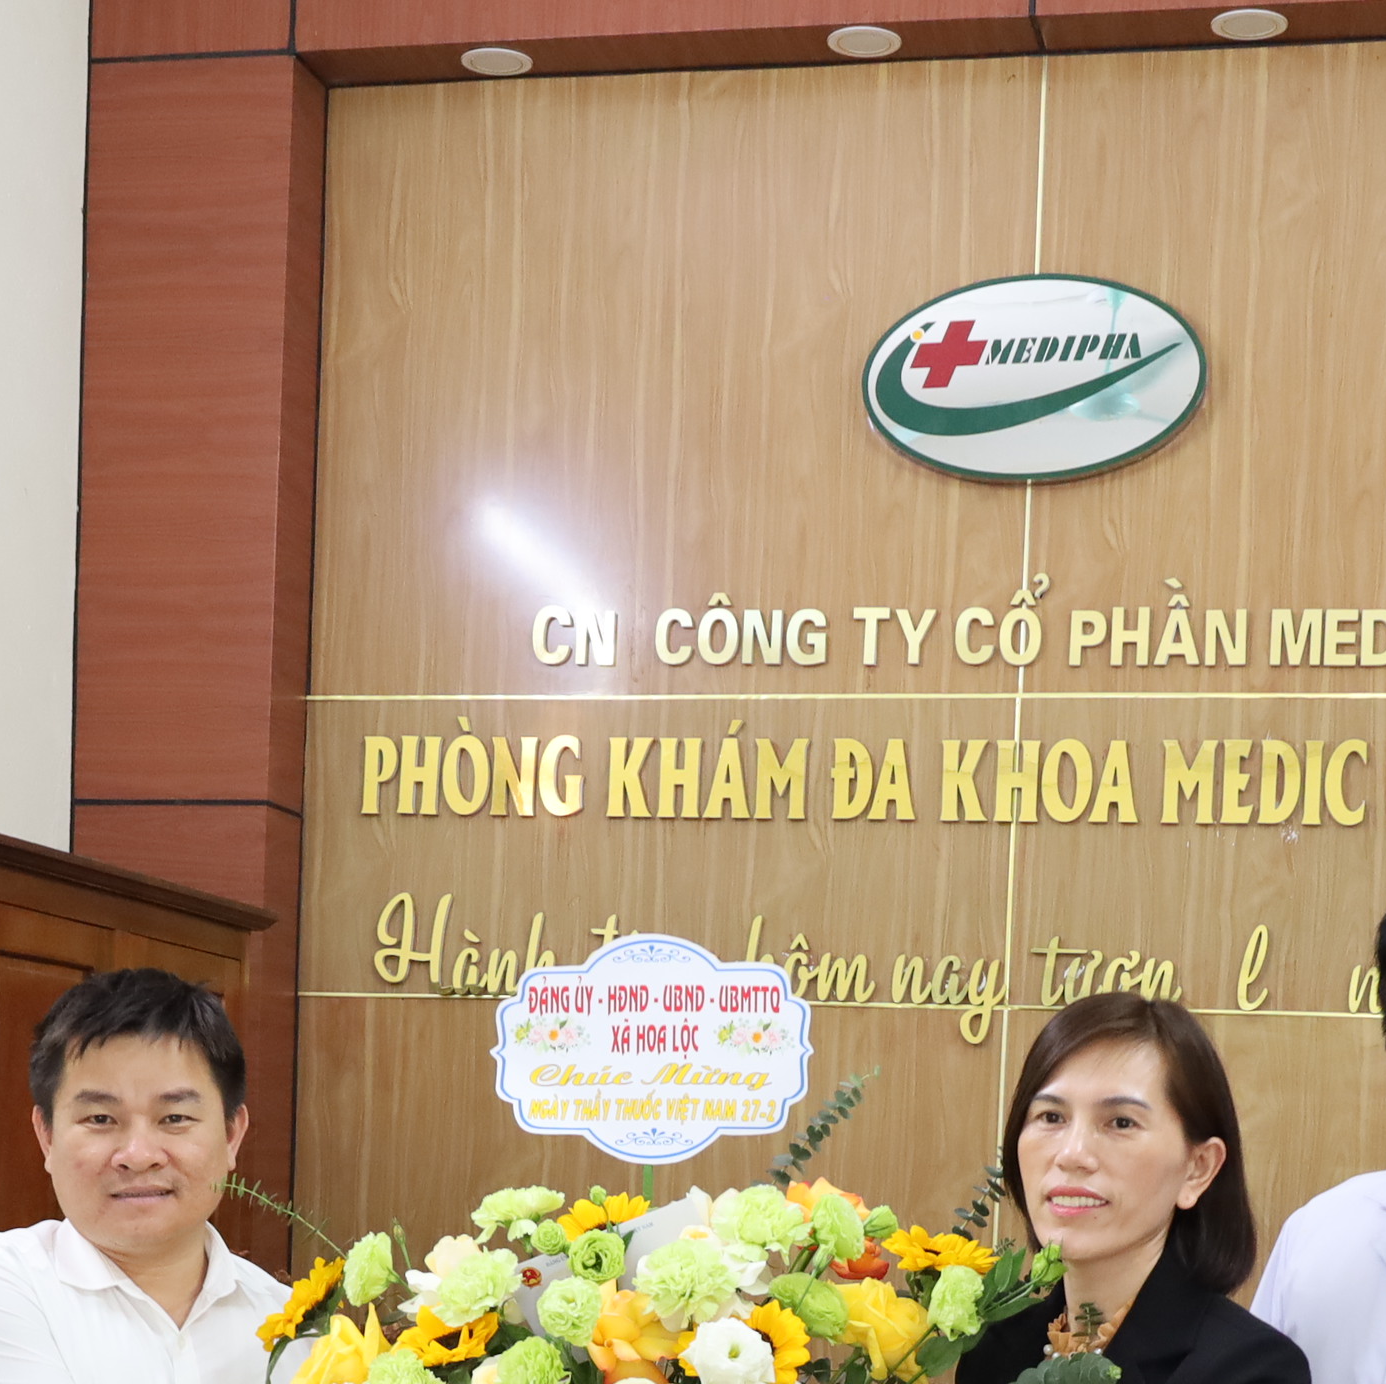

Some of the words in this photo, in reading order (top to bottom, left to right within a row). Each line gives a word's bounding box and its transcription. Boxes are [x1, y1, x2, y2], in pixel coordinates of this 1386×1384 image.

[984, 331, 1142, 366] MEDIPHA
[532, 604, 618, 667] CN
[655, 592, 828, 667] CÔNG
[853, 606, 937, 667] TY
[955, 572, 1051, 667] CỔ
[1068, 577, 1248, 668] PHẦN
[361, 716, 585, 817] PHÒNG
[606, 719, 810, 820] KHÁM
[831, 738, 916, 821] ĐA
[939, 738, 1138, 824] KHOA
[1160, 738, 1368, 827] MEDIC
[528, 976, 570, 1016] ĐẢNG
[575, 976, 593, 1016] ỦY
[607, 985, 649, 1015] HĐND
[663, 984, 705, 1012] UBND
[719, 985, 781, 1013] UBMTTQ
[892, 954, 1007, 1044] nay
[611, 1018, 631, 1056] XÃ
[636, 1024, 667, 1055] HOA
[672, 1018, 699, 1060] LỘC
[529, 1063, 633, 1087] Chúc
[640, 1062, 773, 1091] Mừng
[528, 1093, 570, 1121] NGÀY
[573, 1088, 611, 1122] THẦY
[615, 1089, 663, 1122] THUỐC
[666, 1093, 700, 1125] VIỆT
[702, 1098, 738, 1122] NAM
[741, 1098, 777, 1123] 27-2
